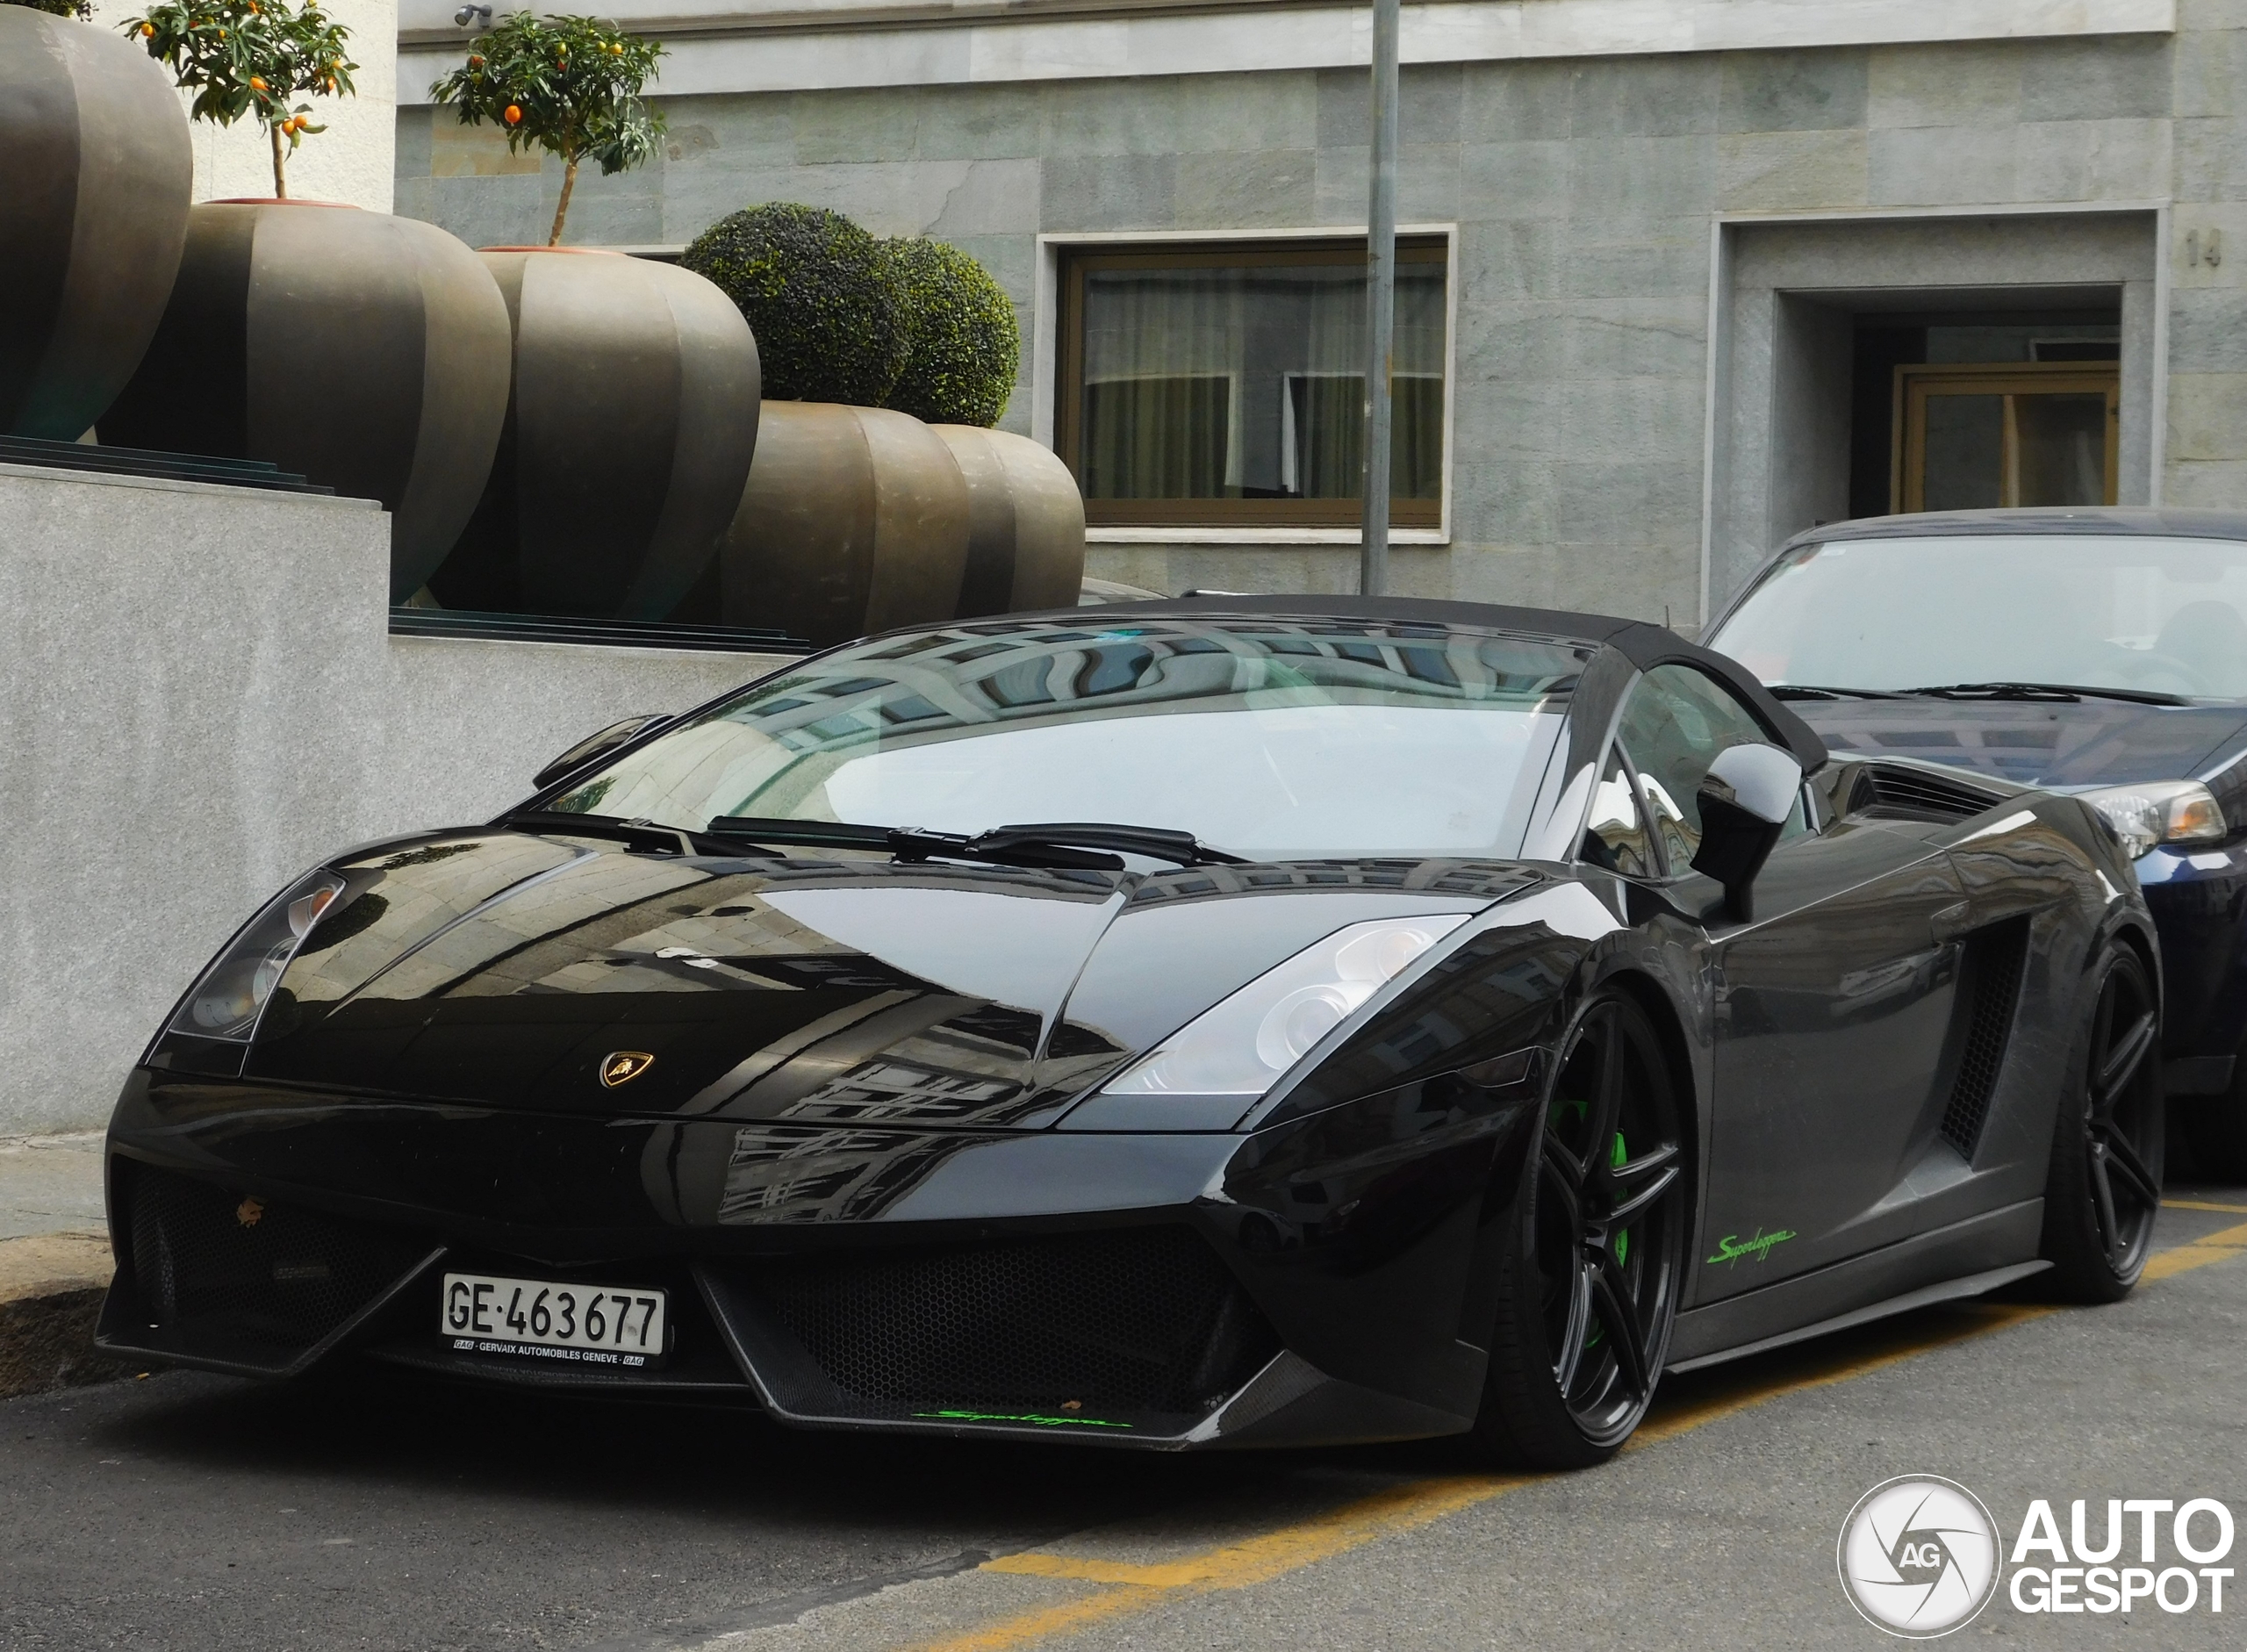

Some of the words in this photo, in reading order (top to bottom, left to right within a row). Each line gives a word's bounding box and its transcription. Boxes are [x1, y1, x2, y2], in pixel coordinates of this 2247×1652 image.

[455, 1340, 474, 1349] GAG
[479, 1342, 516, 1354] GERVAIX
[518, 1346, 581, 1361] AUTOMOBILES
[582, 1352, 618, 1364] GENEVE
[624, 1356, 643, 1366] GAG
